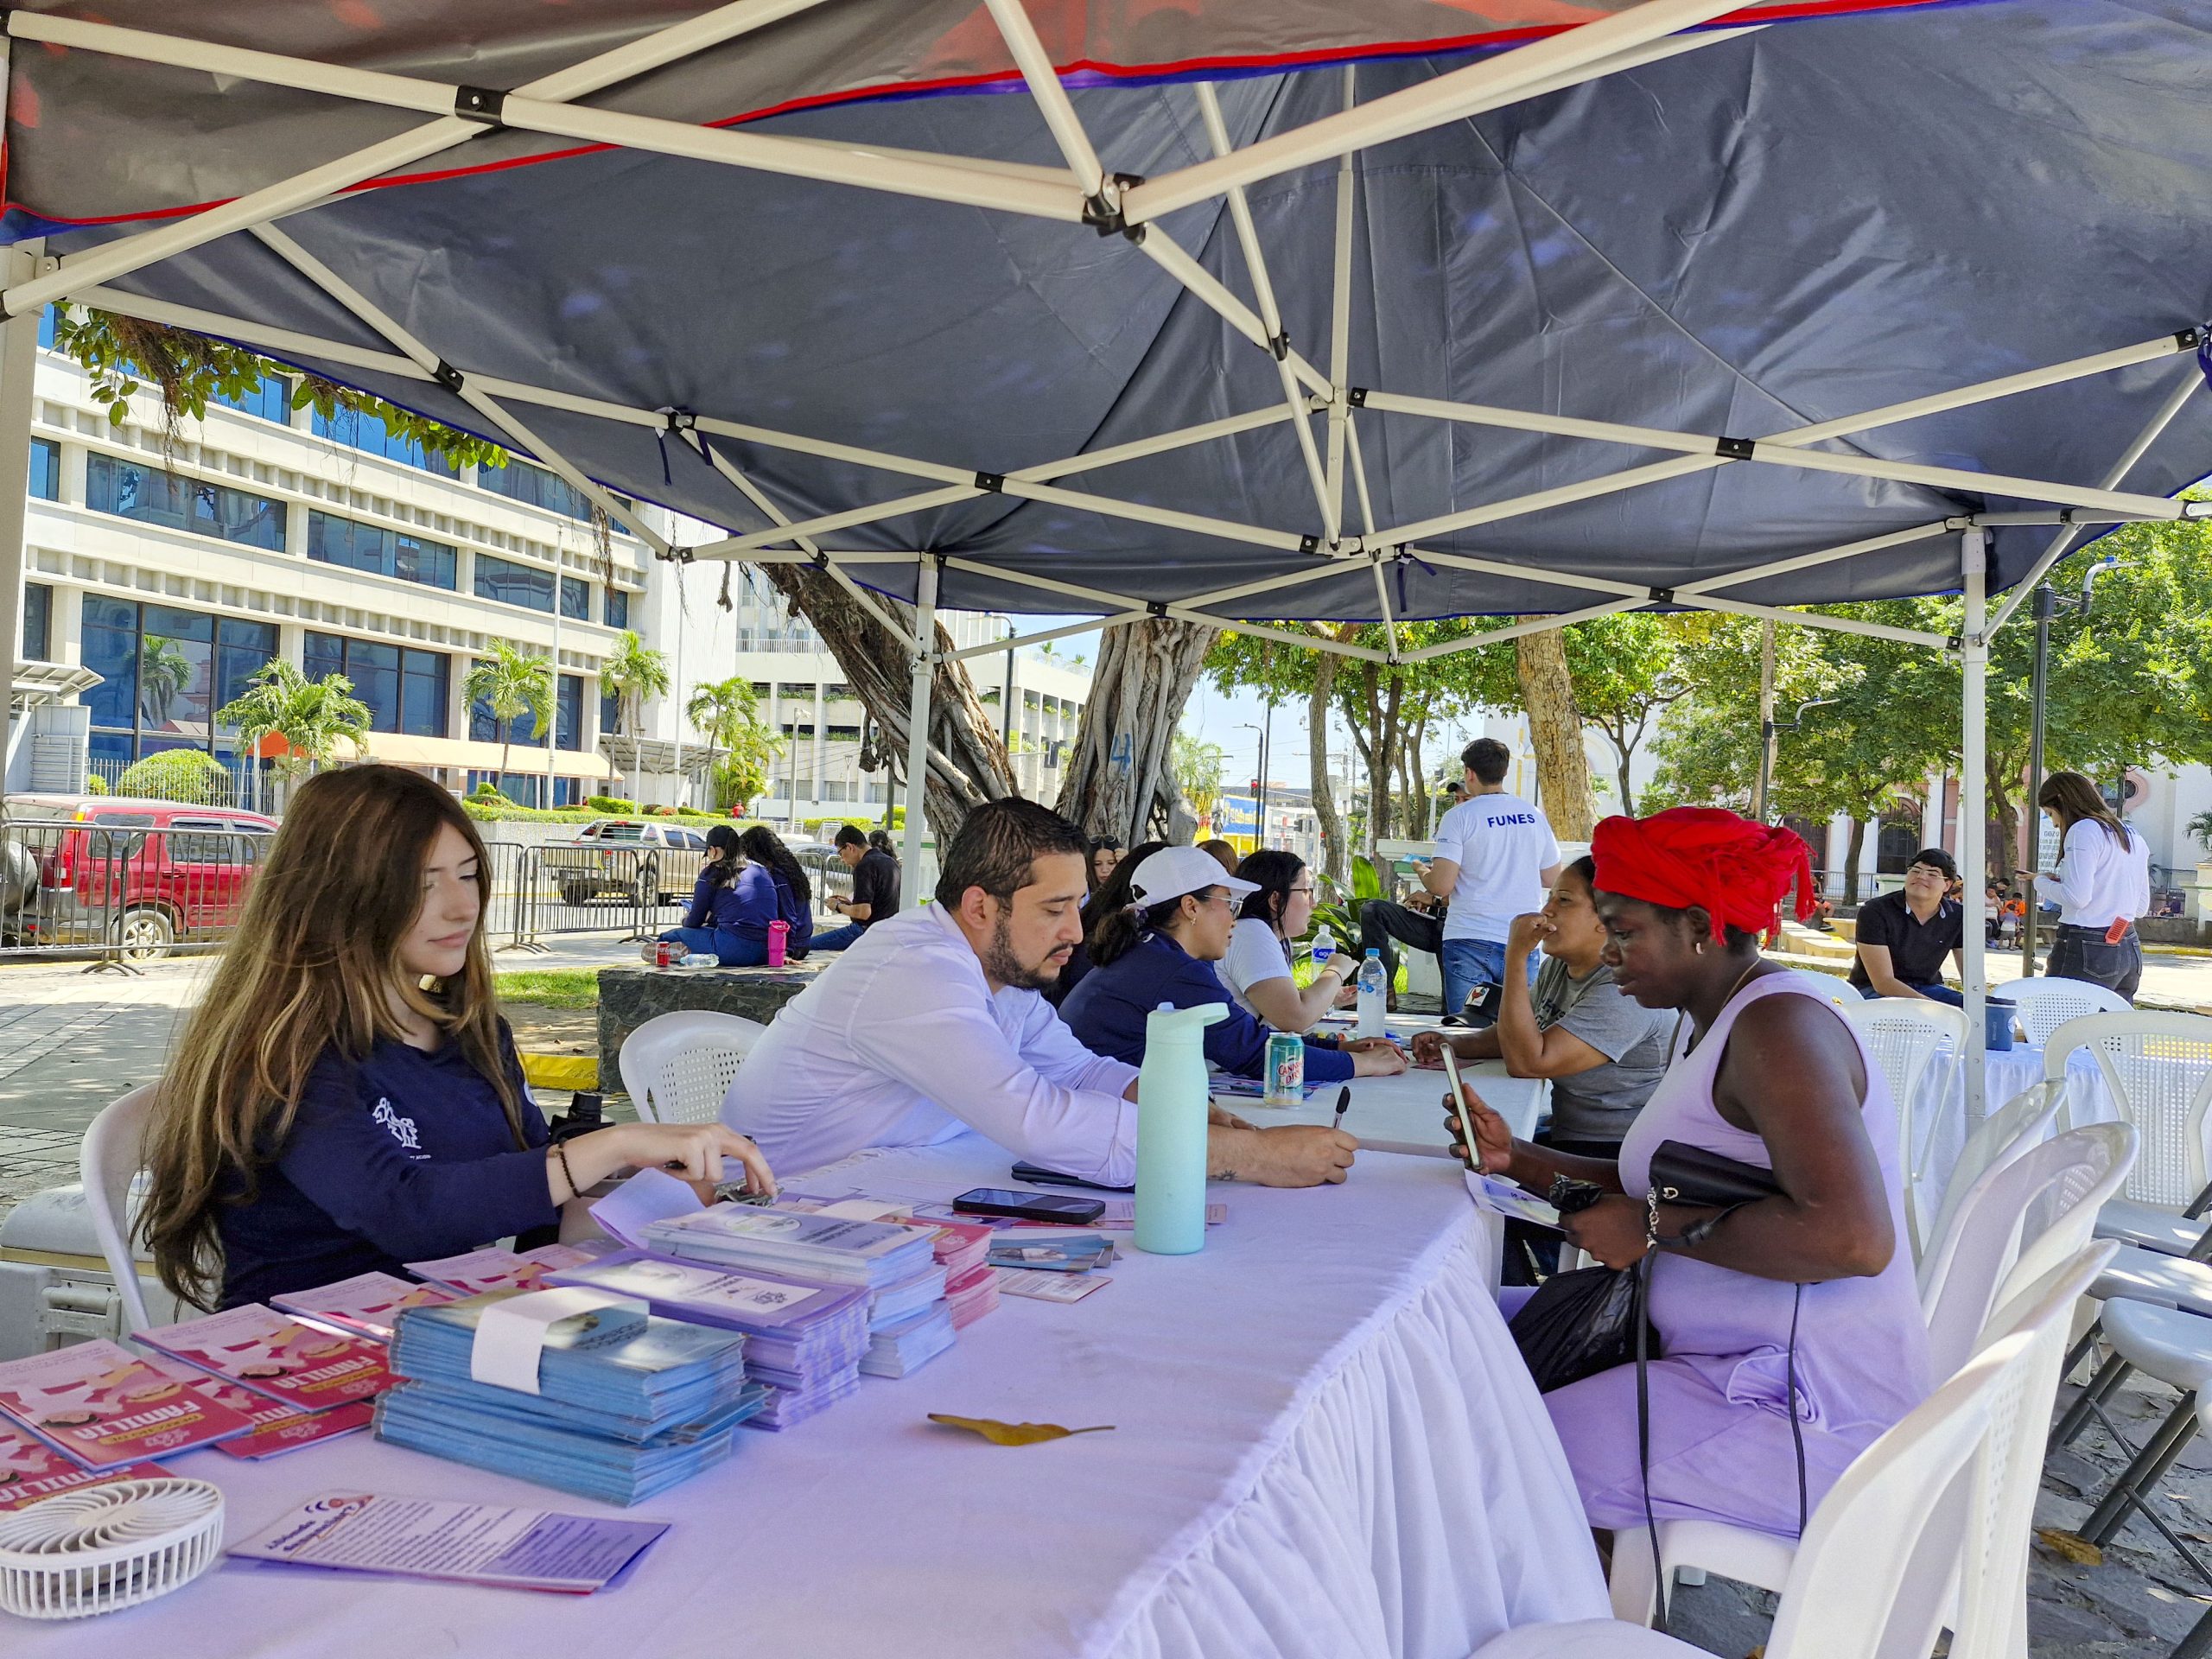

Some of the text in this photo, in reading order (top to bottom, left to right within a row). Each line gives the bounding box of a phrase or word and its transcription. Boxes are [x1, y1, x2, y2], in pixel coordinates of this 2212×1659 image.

[1111, 733, 1130, 772] 4
[1487, 813, 1535, 828] FUNES
[271, 1356, 378, 1389] FAMILIA
[72, 1400, 201, 1440] FAMILIA
